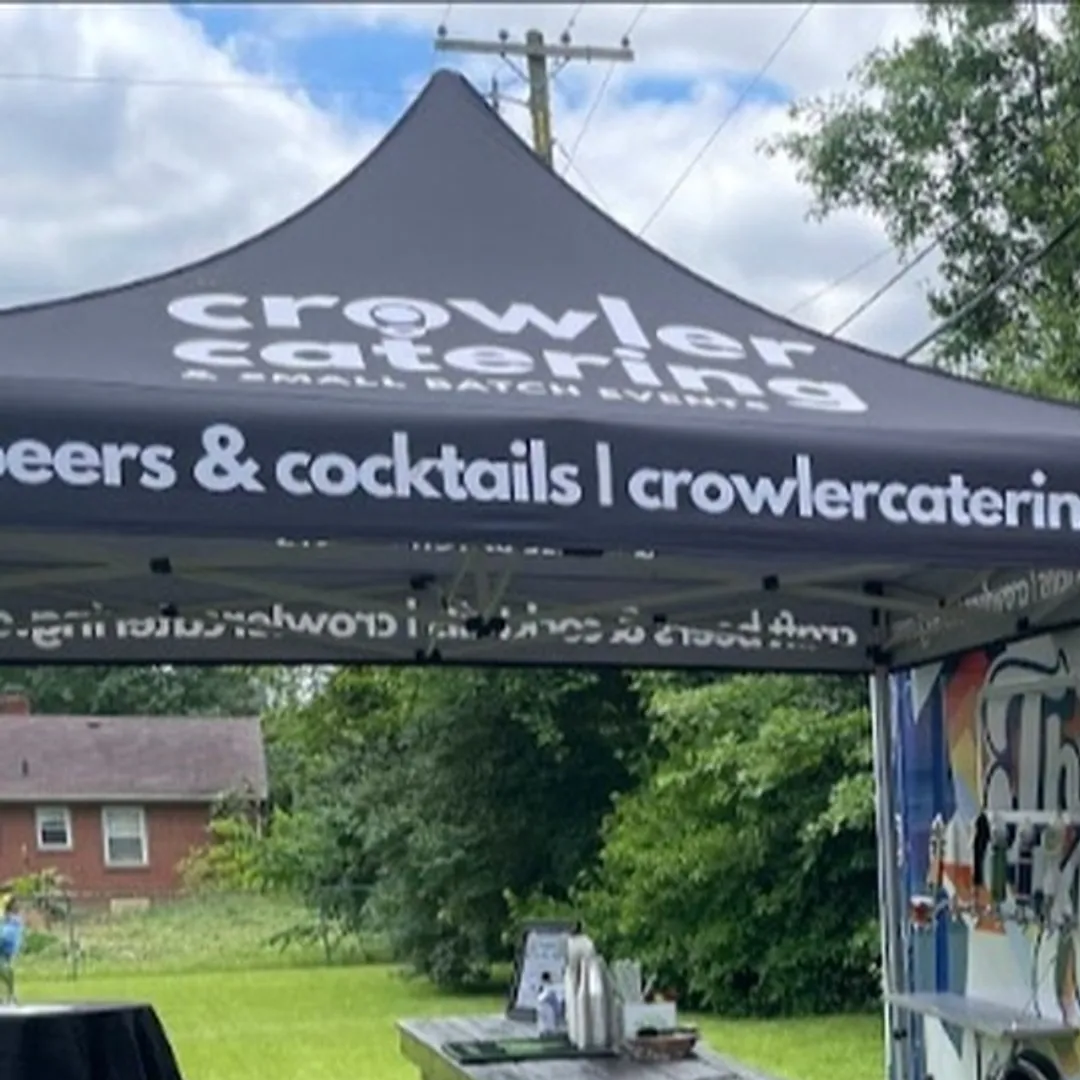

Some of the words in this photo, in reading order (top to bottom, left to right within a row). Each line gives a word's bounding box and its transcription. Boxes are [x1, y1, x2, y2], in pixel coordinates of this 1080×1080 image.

[167, 293, 816, 369] crowler
[172, 338, 868, 413] catering
[425, 376, 581, 397] BATCH
[0, 438, 176, 491] eers
[193, 424, 265, 492] &
[275, 431, 582, 506] cocktails
